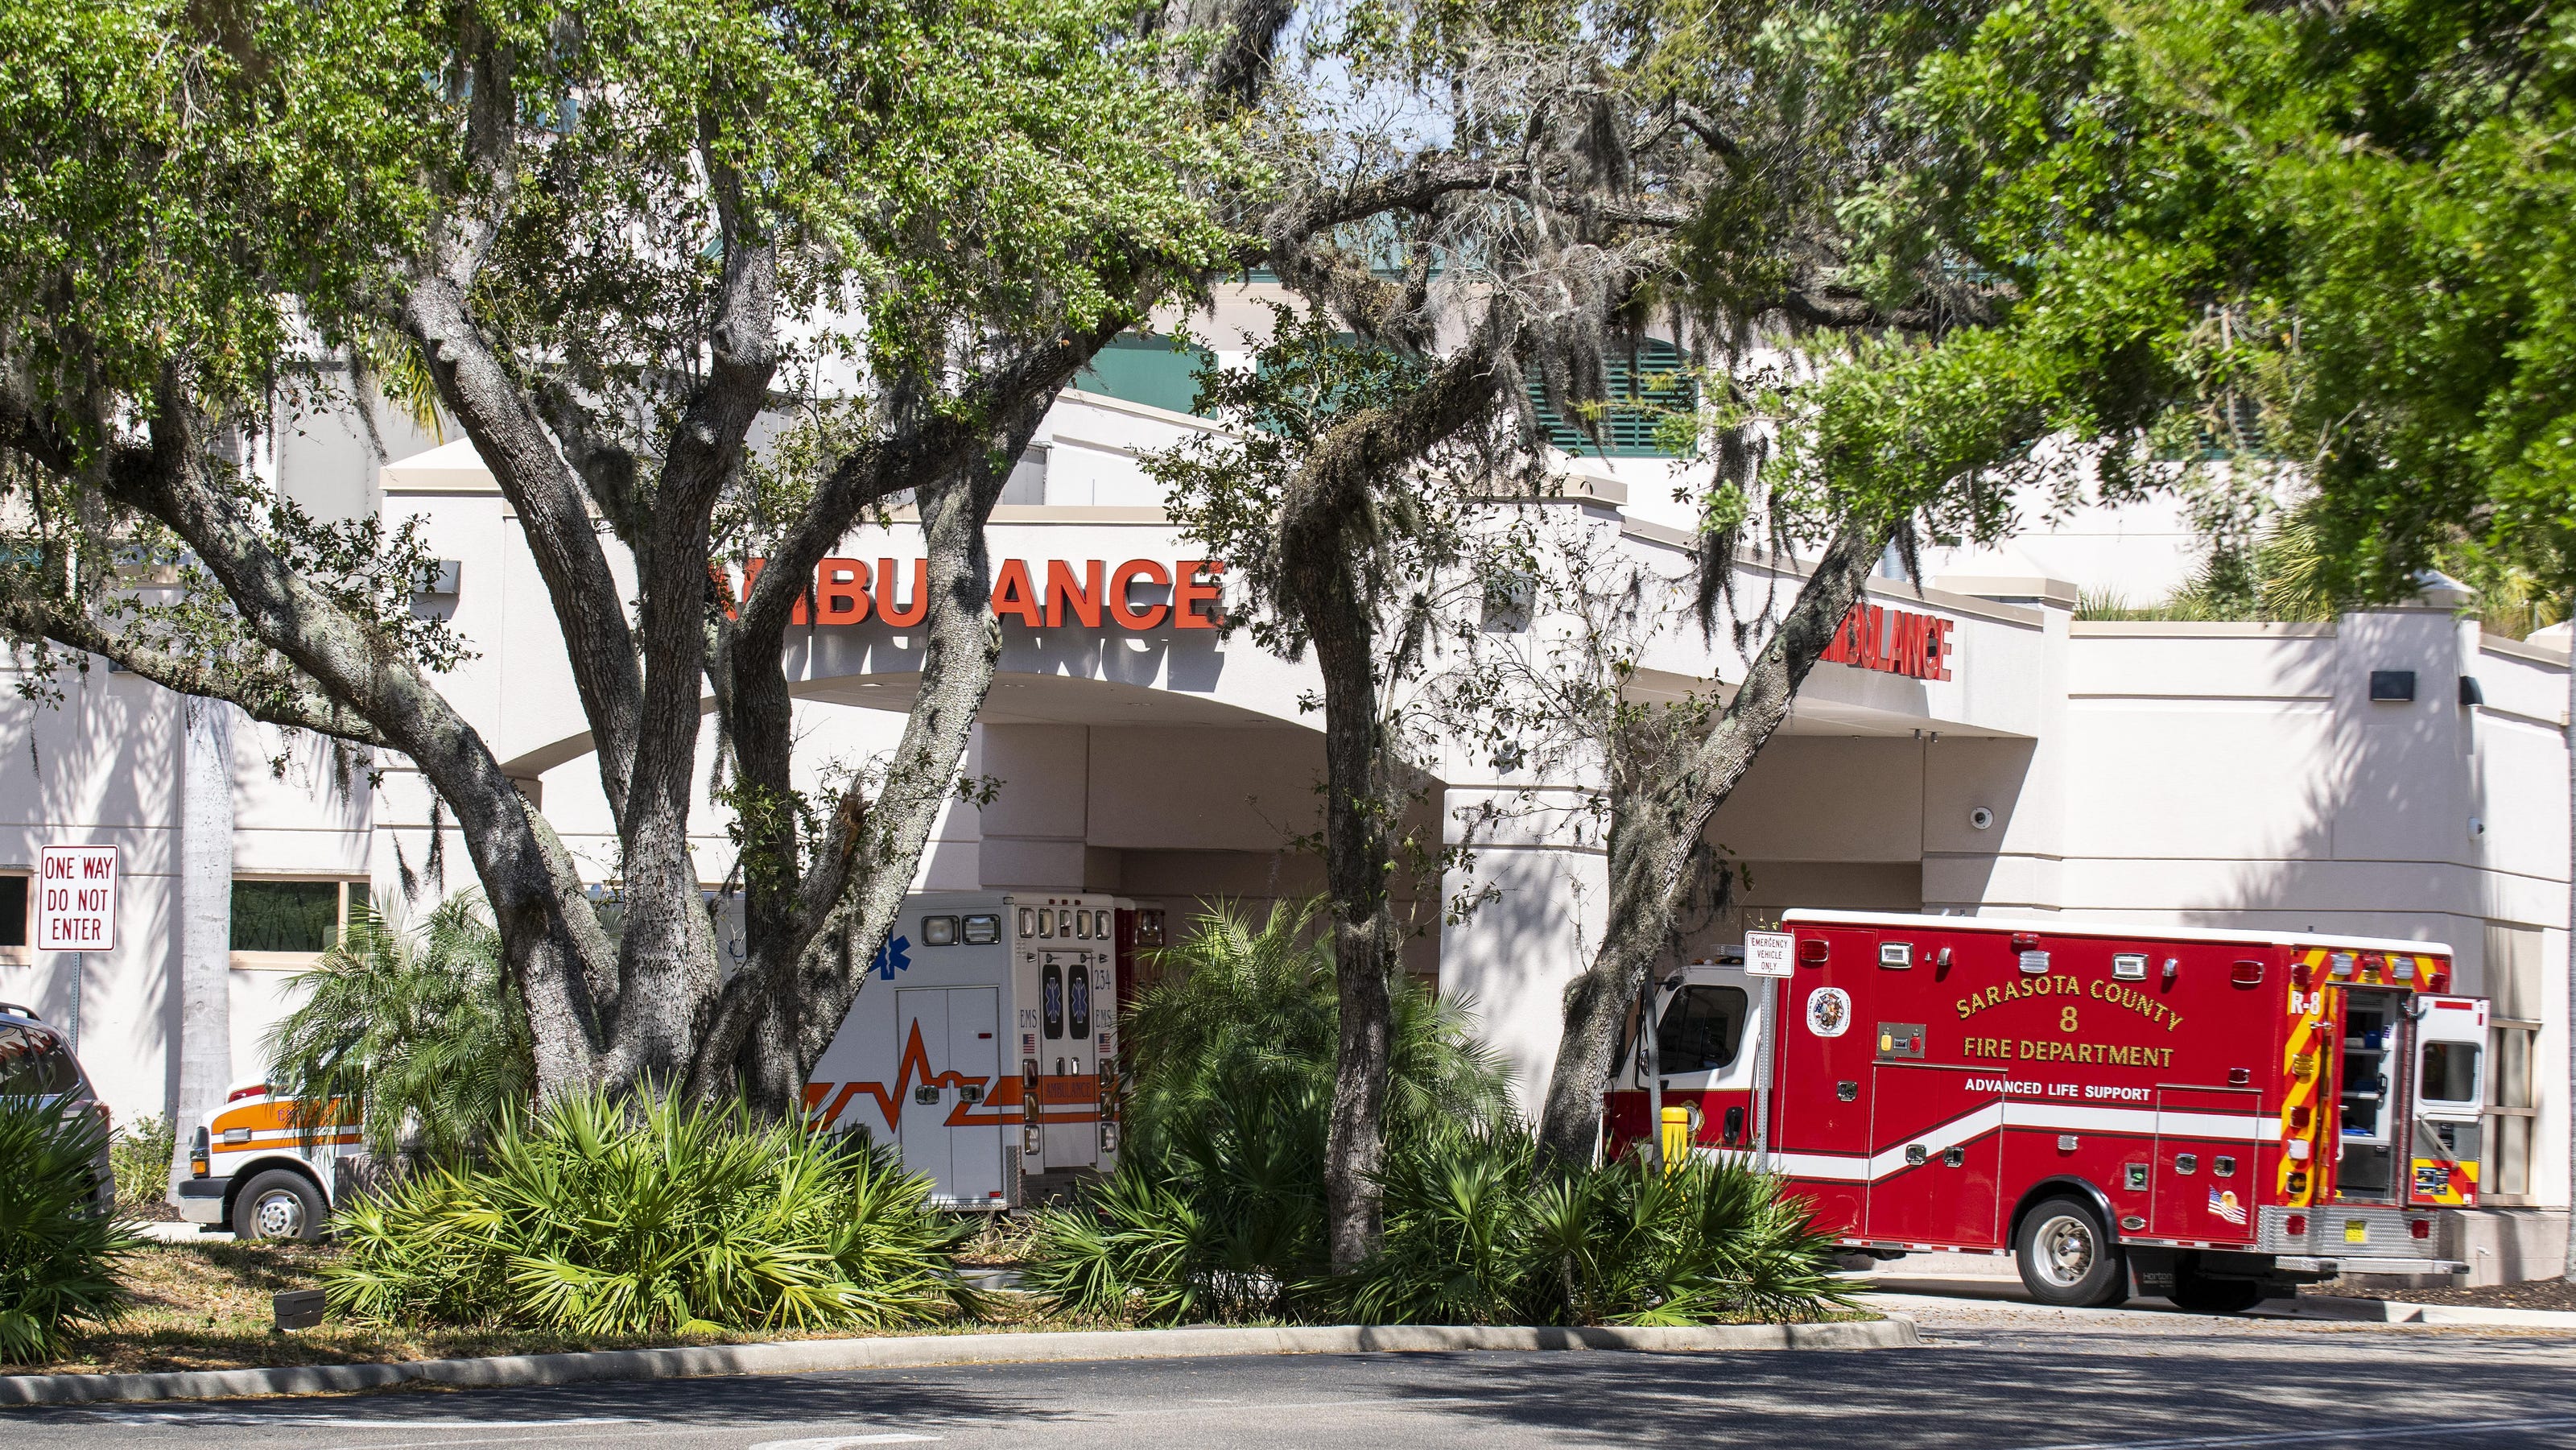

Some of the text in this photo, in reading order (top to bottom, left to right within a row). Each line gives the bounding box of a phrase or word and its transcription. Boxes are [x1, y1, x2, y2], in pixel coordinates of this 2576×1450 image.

[708, 557, 1225, 630] BUANCE
[1818, 601, 1954, 682] BULANCE
[45, 857, 114, 879] ONE WAY
[47, 889, 108, 911] DO NOT
[52, 918, 101, 940] ENTER
[1752, 937, 1788, 948] EMERGENCY
[1757, 949, 1782, 960] VEHICLE
[1761, 961, 1777, 971] ONLY
[1095, 969, 1111, 989] 234
[1956, 975, 2185, 1032] SARASOTA COUNTY
[2291, 990, 2320, 1015] R-8
[1020, 1009, 1038, 1029] EMS
[1096, 1009, 1113, 1029] EMS
[2059, 1006, 2079, 1033] 8
[1963, 1037, 2174, 1068] FIRE DEPARTMENT
[1046, 1081, 1092, 1098] AMBULANCE
[1964, 1077, 2152, 1101] ADVANCED LIFE SUPPORT
